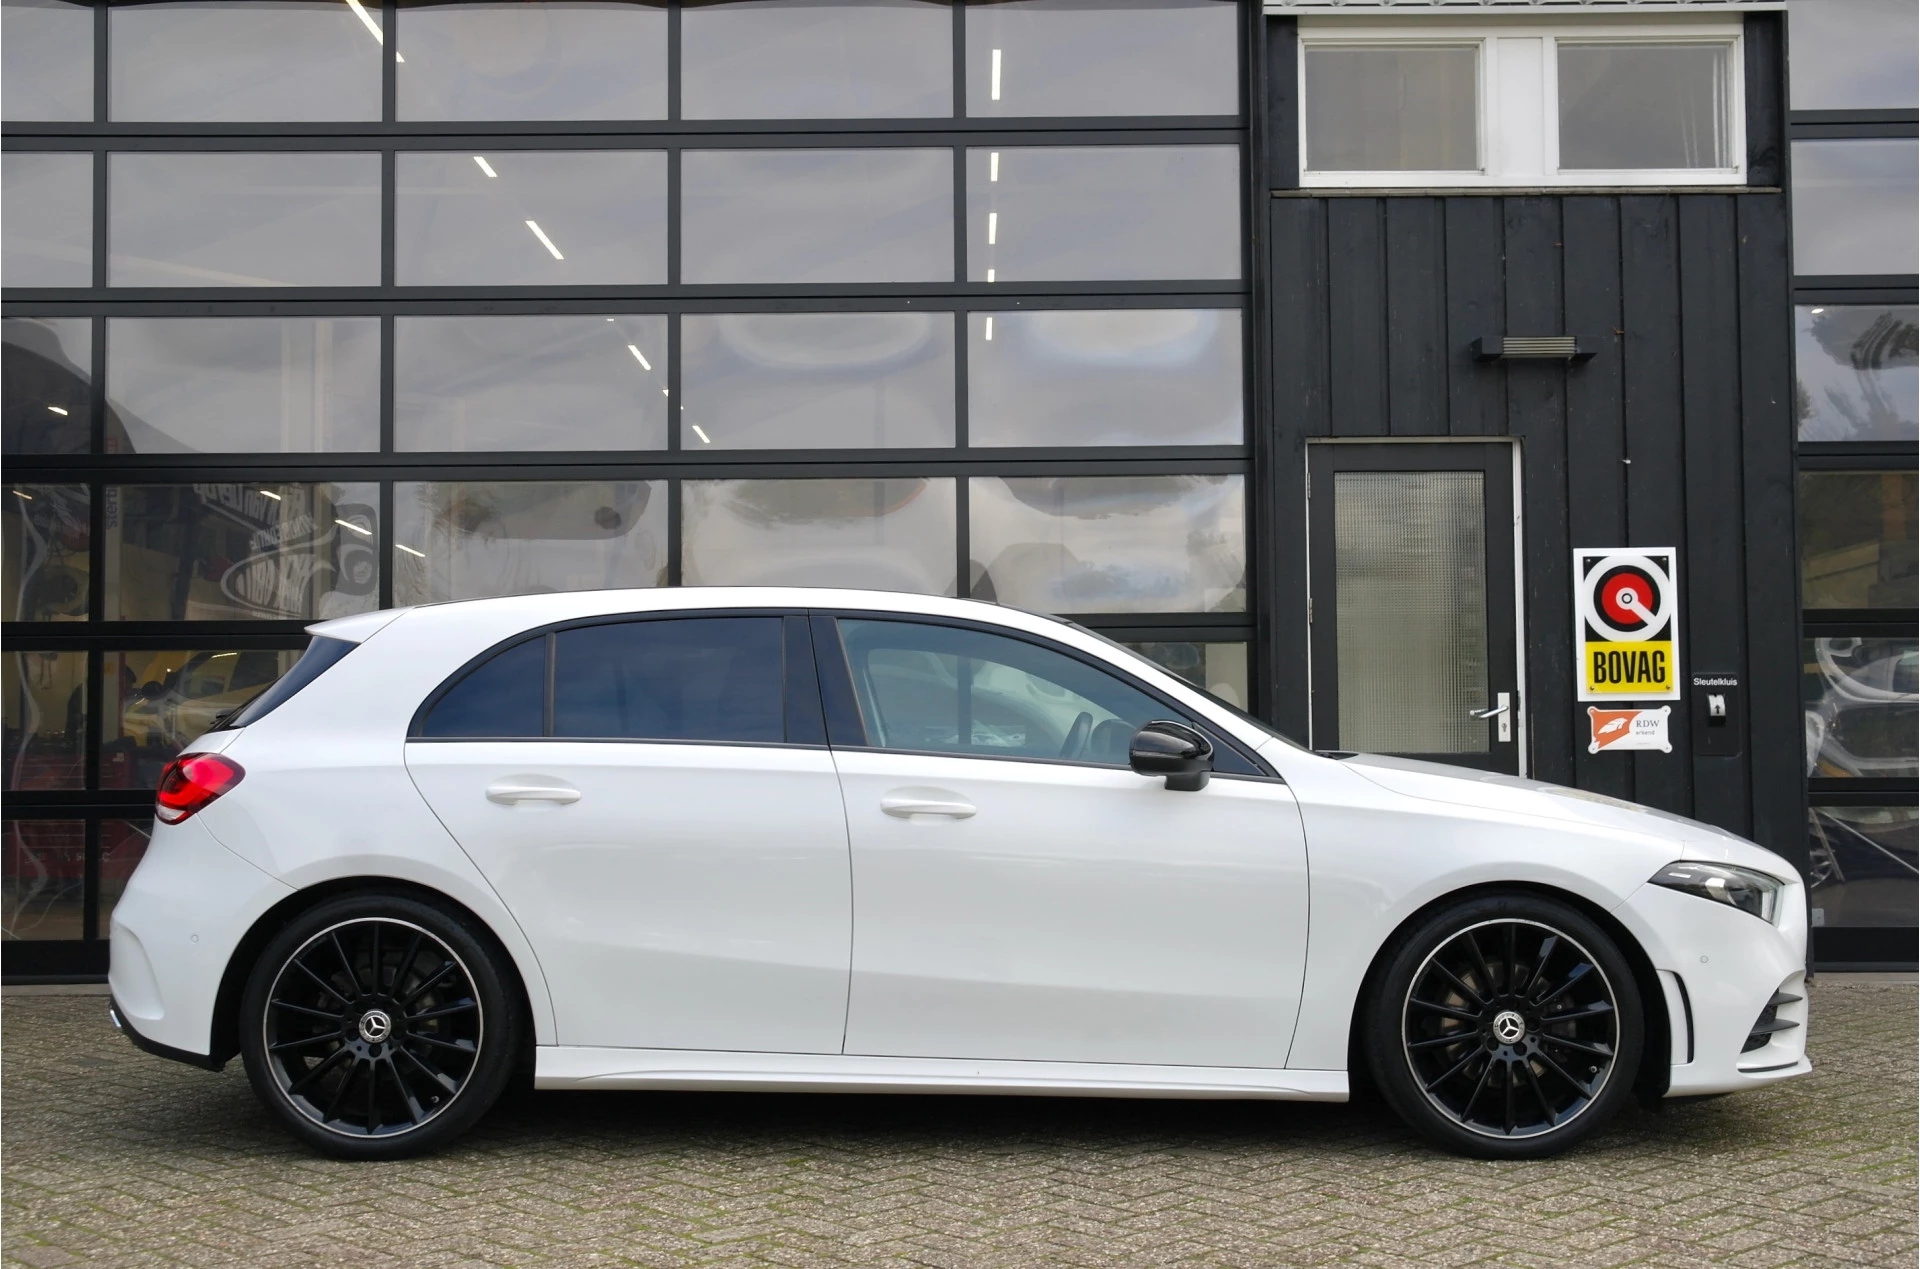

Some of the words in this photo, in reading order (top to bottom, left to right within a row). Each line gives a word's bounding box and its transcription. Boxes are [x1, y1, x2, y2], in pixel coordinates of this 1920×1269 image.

[1593, 650, 1666, 684] BOVAG
[1693, 677, 1738, 686] Sleutelkluis
[1635, 719, 1660, 728] RDW
